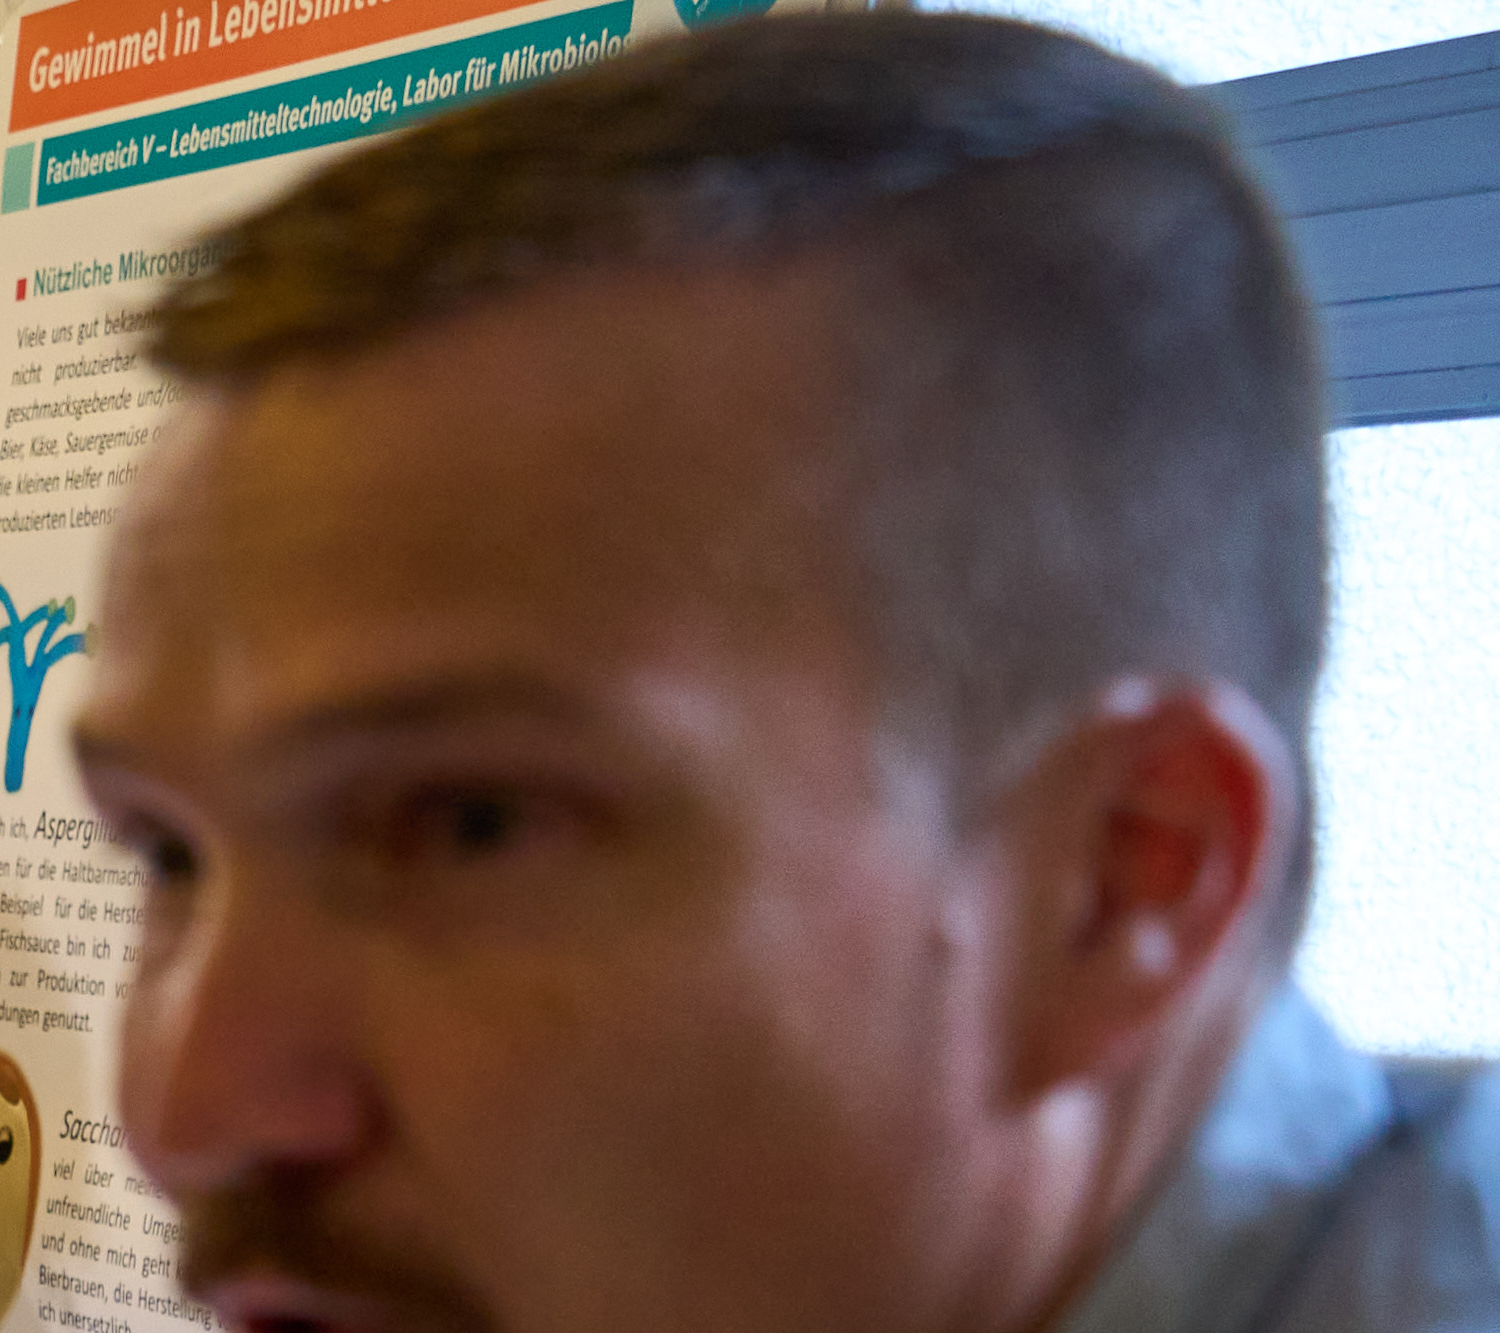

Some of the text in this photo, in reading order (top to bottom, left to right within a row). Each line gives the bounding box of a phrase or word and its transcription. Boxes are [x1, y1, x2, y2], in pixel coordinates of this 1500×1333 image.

[28, 11, 167, 93] Gewimmel
[173, 4, 201, 56] in
[46, 136, 139, 185] Fachbereich
[142, 134, 155, 164] V
[170, 80, 398, 158] Lebensmitteltechnologie,
[402, 68, 462, 106] Labor
[464, 57, 496, 93] für
[33, 259, 113, 297] Nützliche
[16, 320, 99, 348] Viele uns gut
[11, 363, 42, 386] nicht
[5, 387, 132, 429] geschmacksgebende
[65, 425, 148, 455] Sauergemüse
[16, 471, 60, 496] kleinen
[64, 465, 103, 489] Helfer
[107, 461, 139, 487] nicht
[16, 855, 32, 878] für
[38, 858, 57, 881] die
[0, 893, 44, 919] Beispiel
[54, 895, 73, 919] für
[78, 899, 97, 921] die
[0, 929, 60, 955] Fischsauce
[67, 934, 86, 957] bin
[92, 937, 111, 960] ich
[10, 969, 29, 988] zur
[37, 969, 106, 996] Produktion
[42, 1010, 93, 1033] genutzt.
[53, 1160, 75, 1180] viel
[84, 1163, 114, 1188] über
[46, 1196, 131, 1231] unfreundliche
[41, 1232, 64, 1253] und
[69, 1237, 100, 1261] ohne
[106, 1245, 137, 1270] mich
[141, 1255, 171, 1278] geht
[38, 1300, 56, 1322] ich
[39, 1263, 213, 1331] Bierbrauen, die Herstellung
